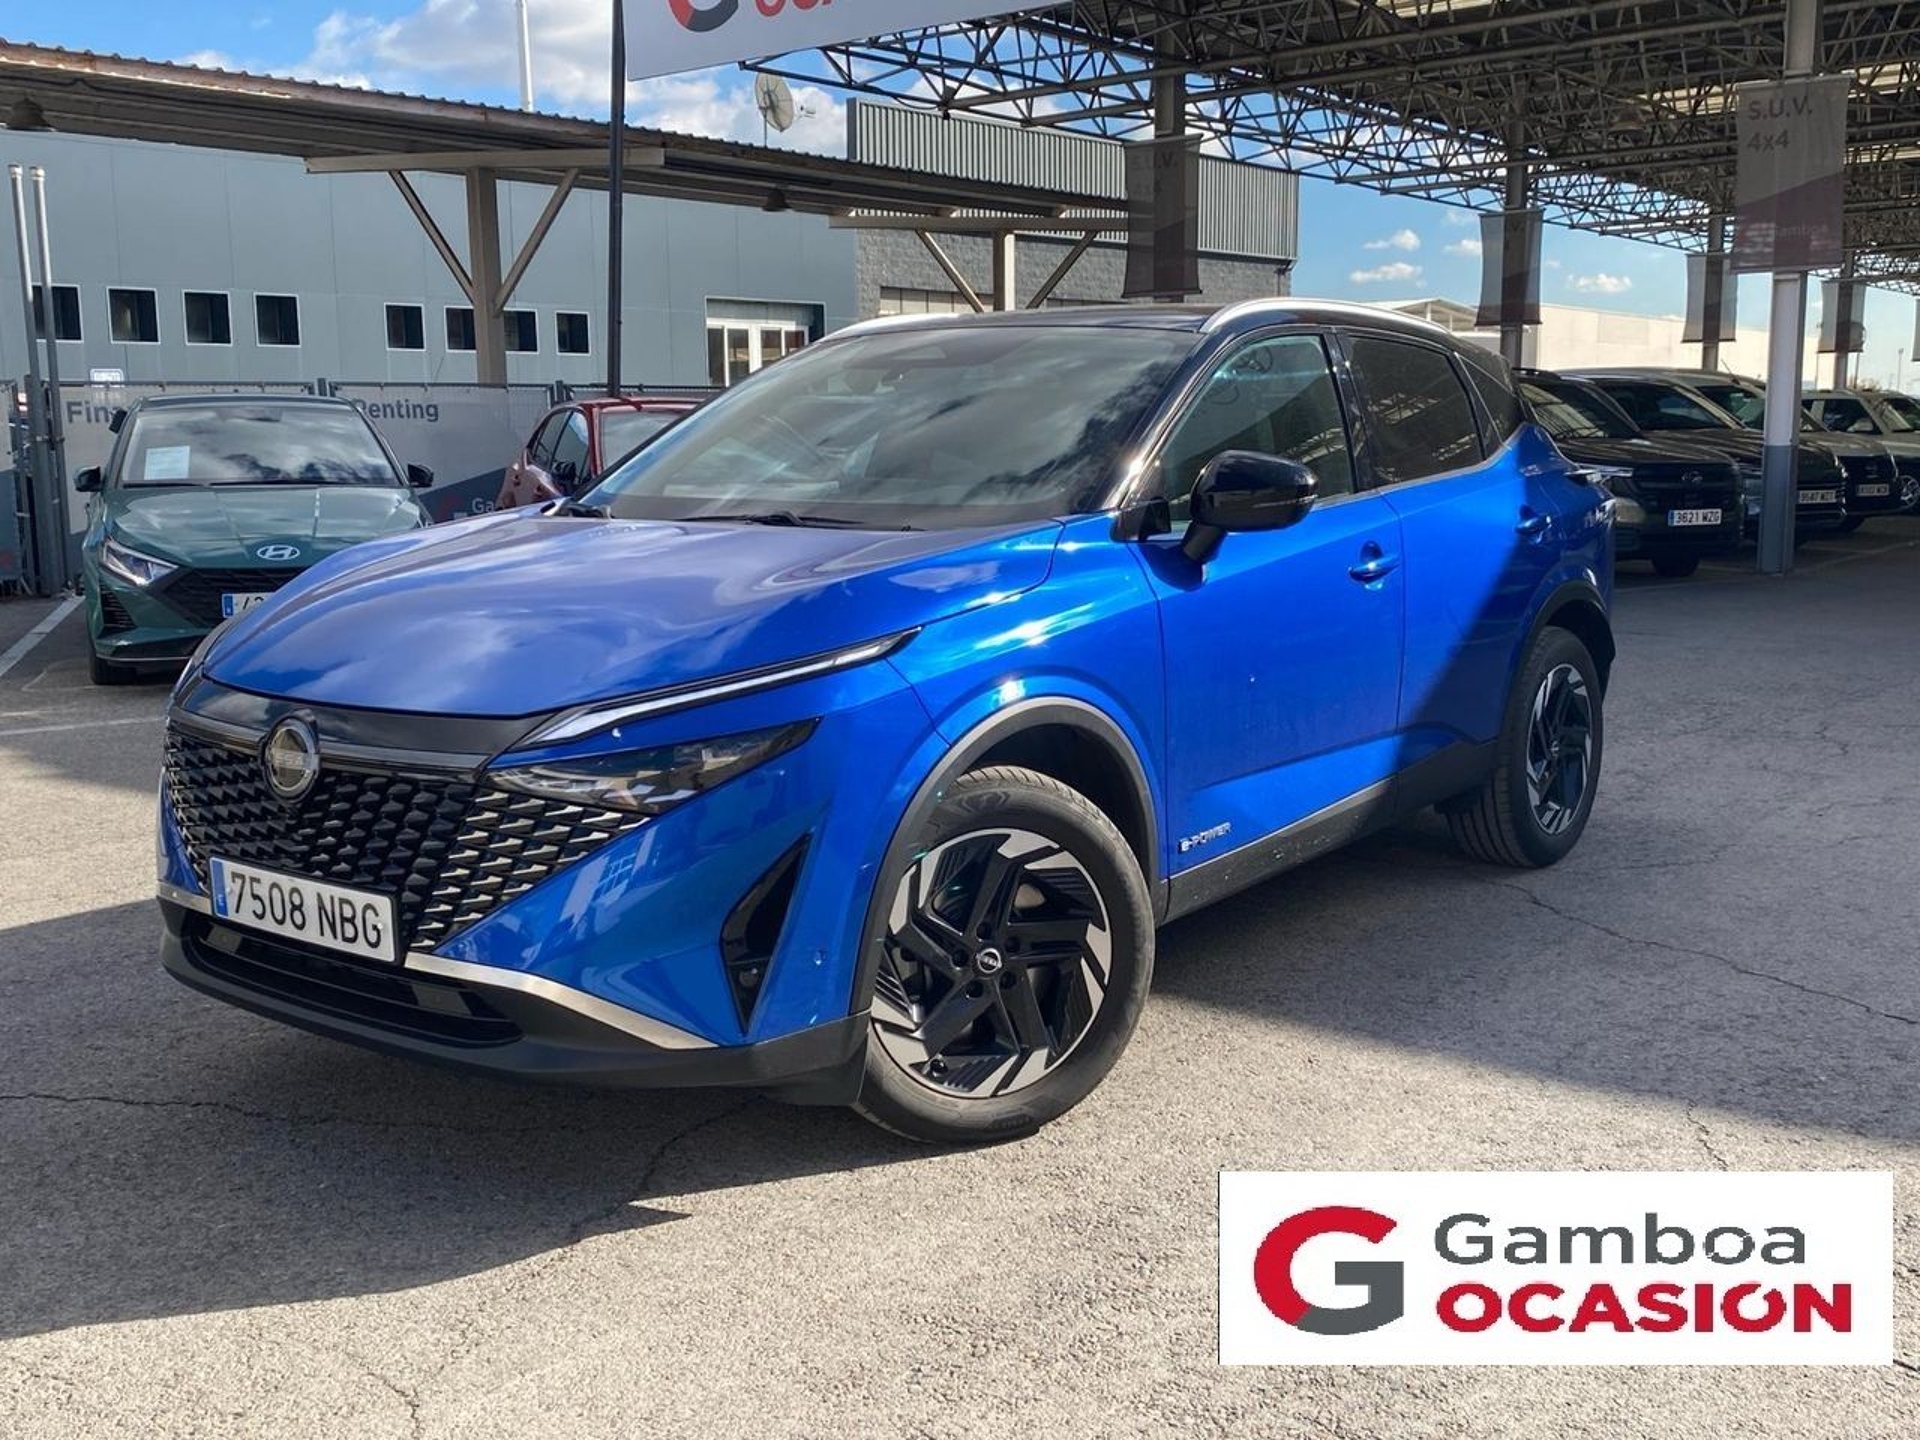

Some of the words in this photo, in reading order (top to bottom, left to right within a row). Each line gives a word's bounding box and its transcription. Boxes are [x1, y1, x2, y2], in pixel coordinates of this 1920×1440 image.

[1749, 96, 1813, 121] S.U.V.
[1747, 129, 1790, 151] 4x4
[67, 401, 120, 423] Fin
[231, 871, 306, 931] 7508
[316, 892, 381, 948] NBG
